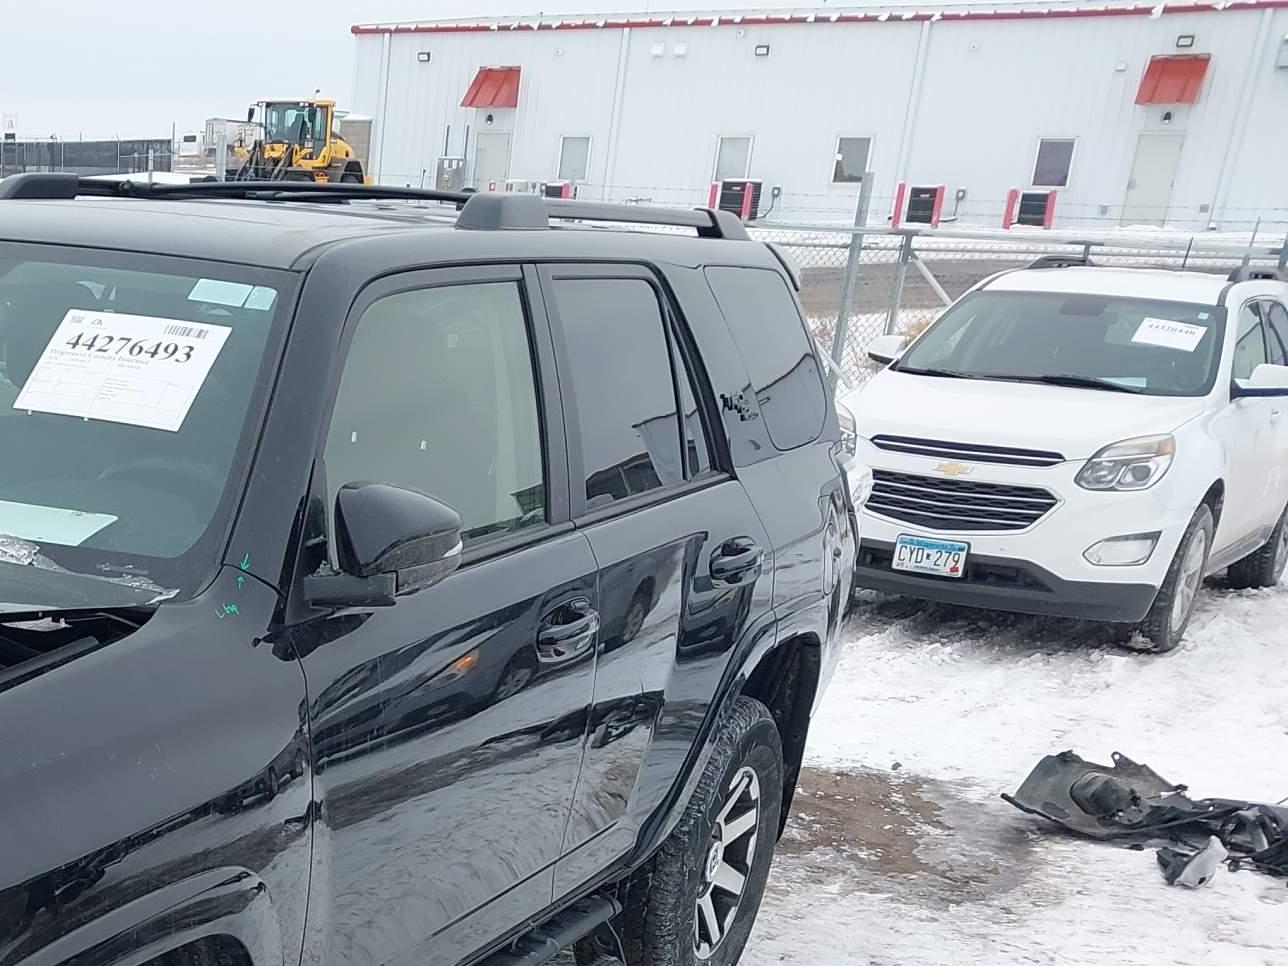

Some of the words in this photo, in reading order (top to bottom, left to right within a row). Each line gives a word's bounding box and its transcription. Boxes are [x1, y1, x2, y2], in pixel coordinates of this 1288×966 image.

[65, 332, 195, 363] 44276493
[898, 545, 925, 564] CYD
[933, 550, 961, 567] 279
